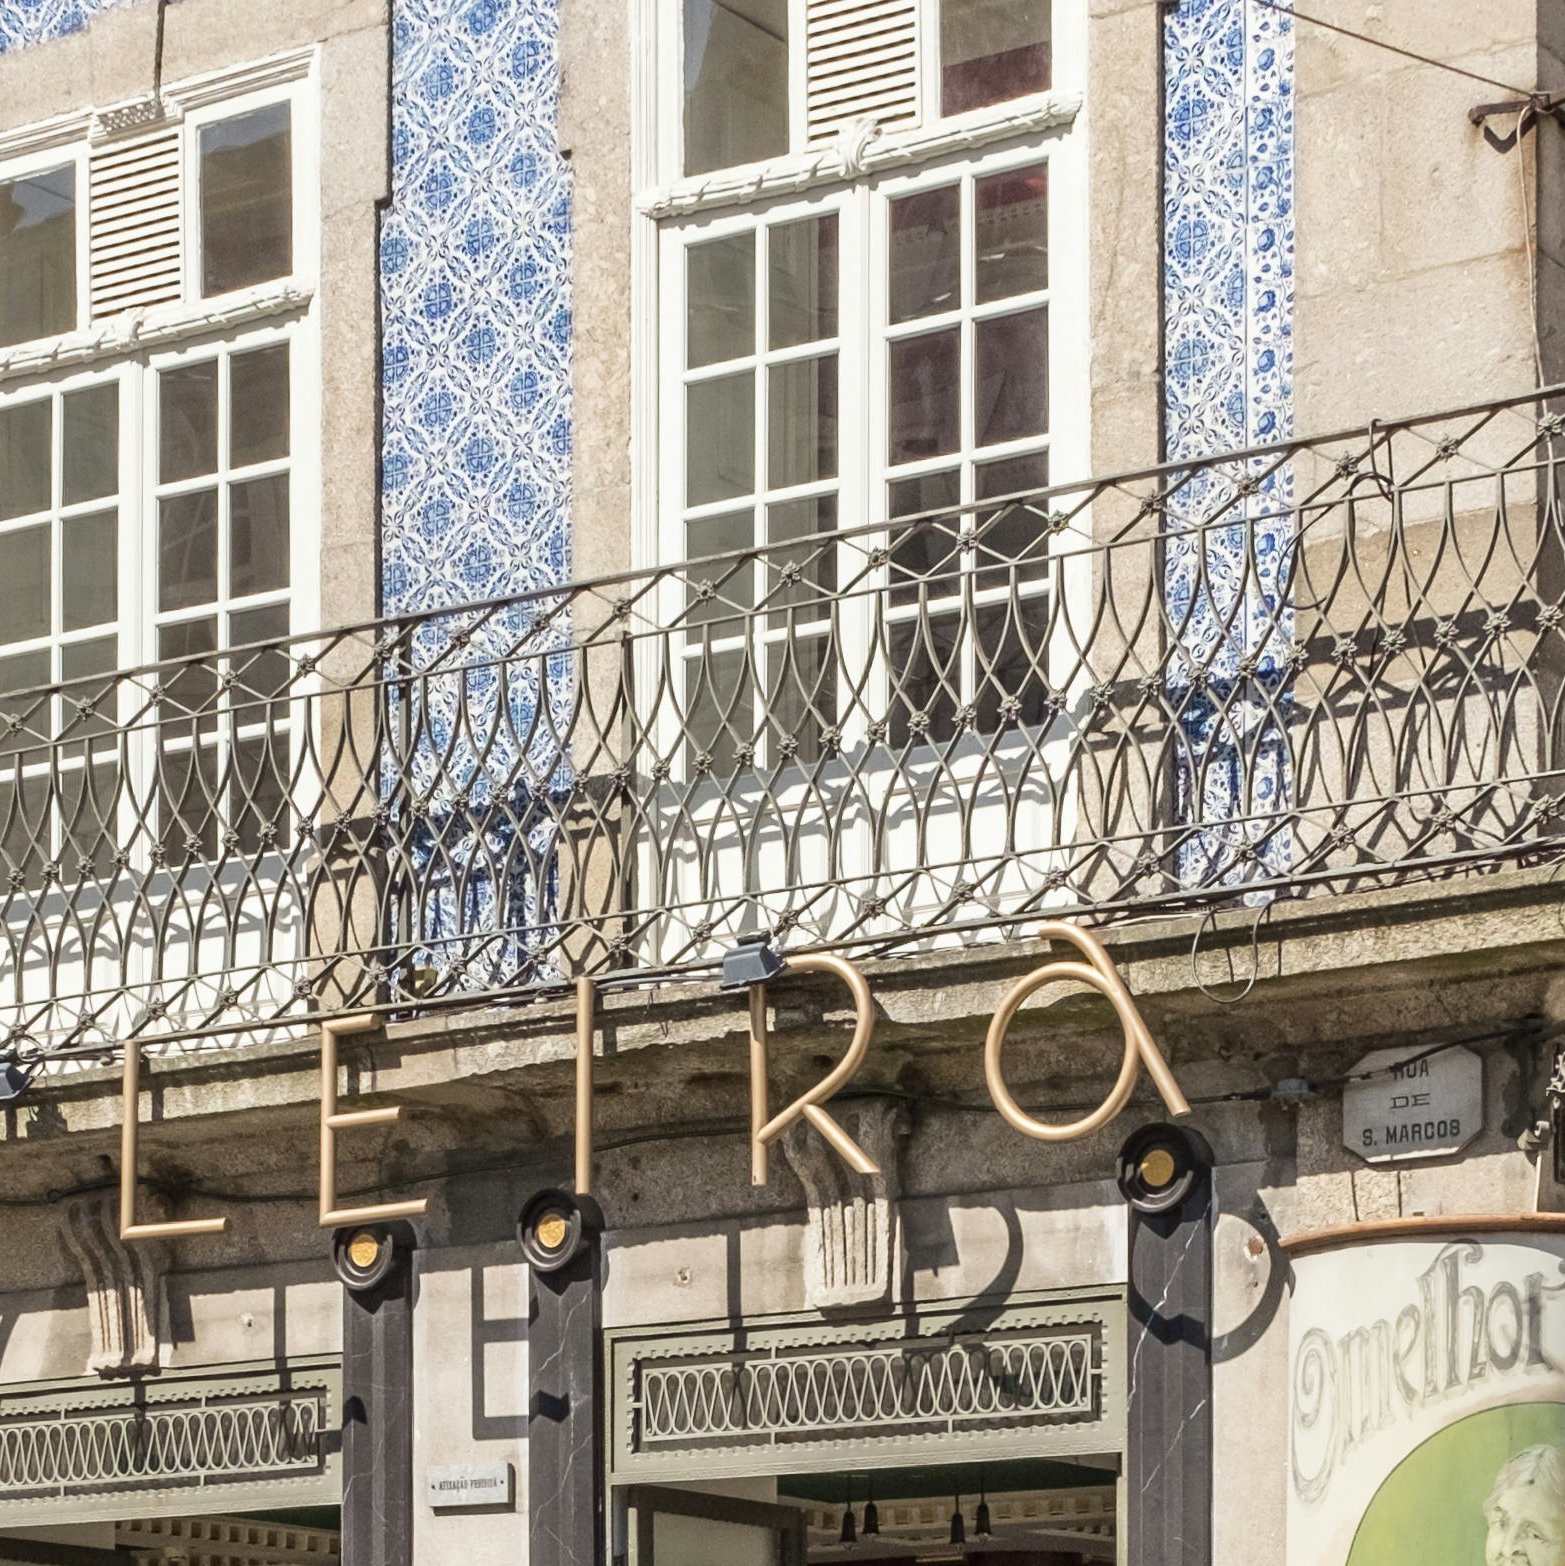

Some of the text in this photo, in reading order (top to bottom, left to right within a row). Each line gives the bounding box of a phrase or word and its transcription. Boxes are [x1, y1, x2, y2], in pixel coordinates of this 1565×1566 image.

[1390, 1093, 1430, 1109] DE
[1362, 1119, 1461, 1146] S. MARCOS
